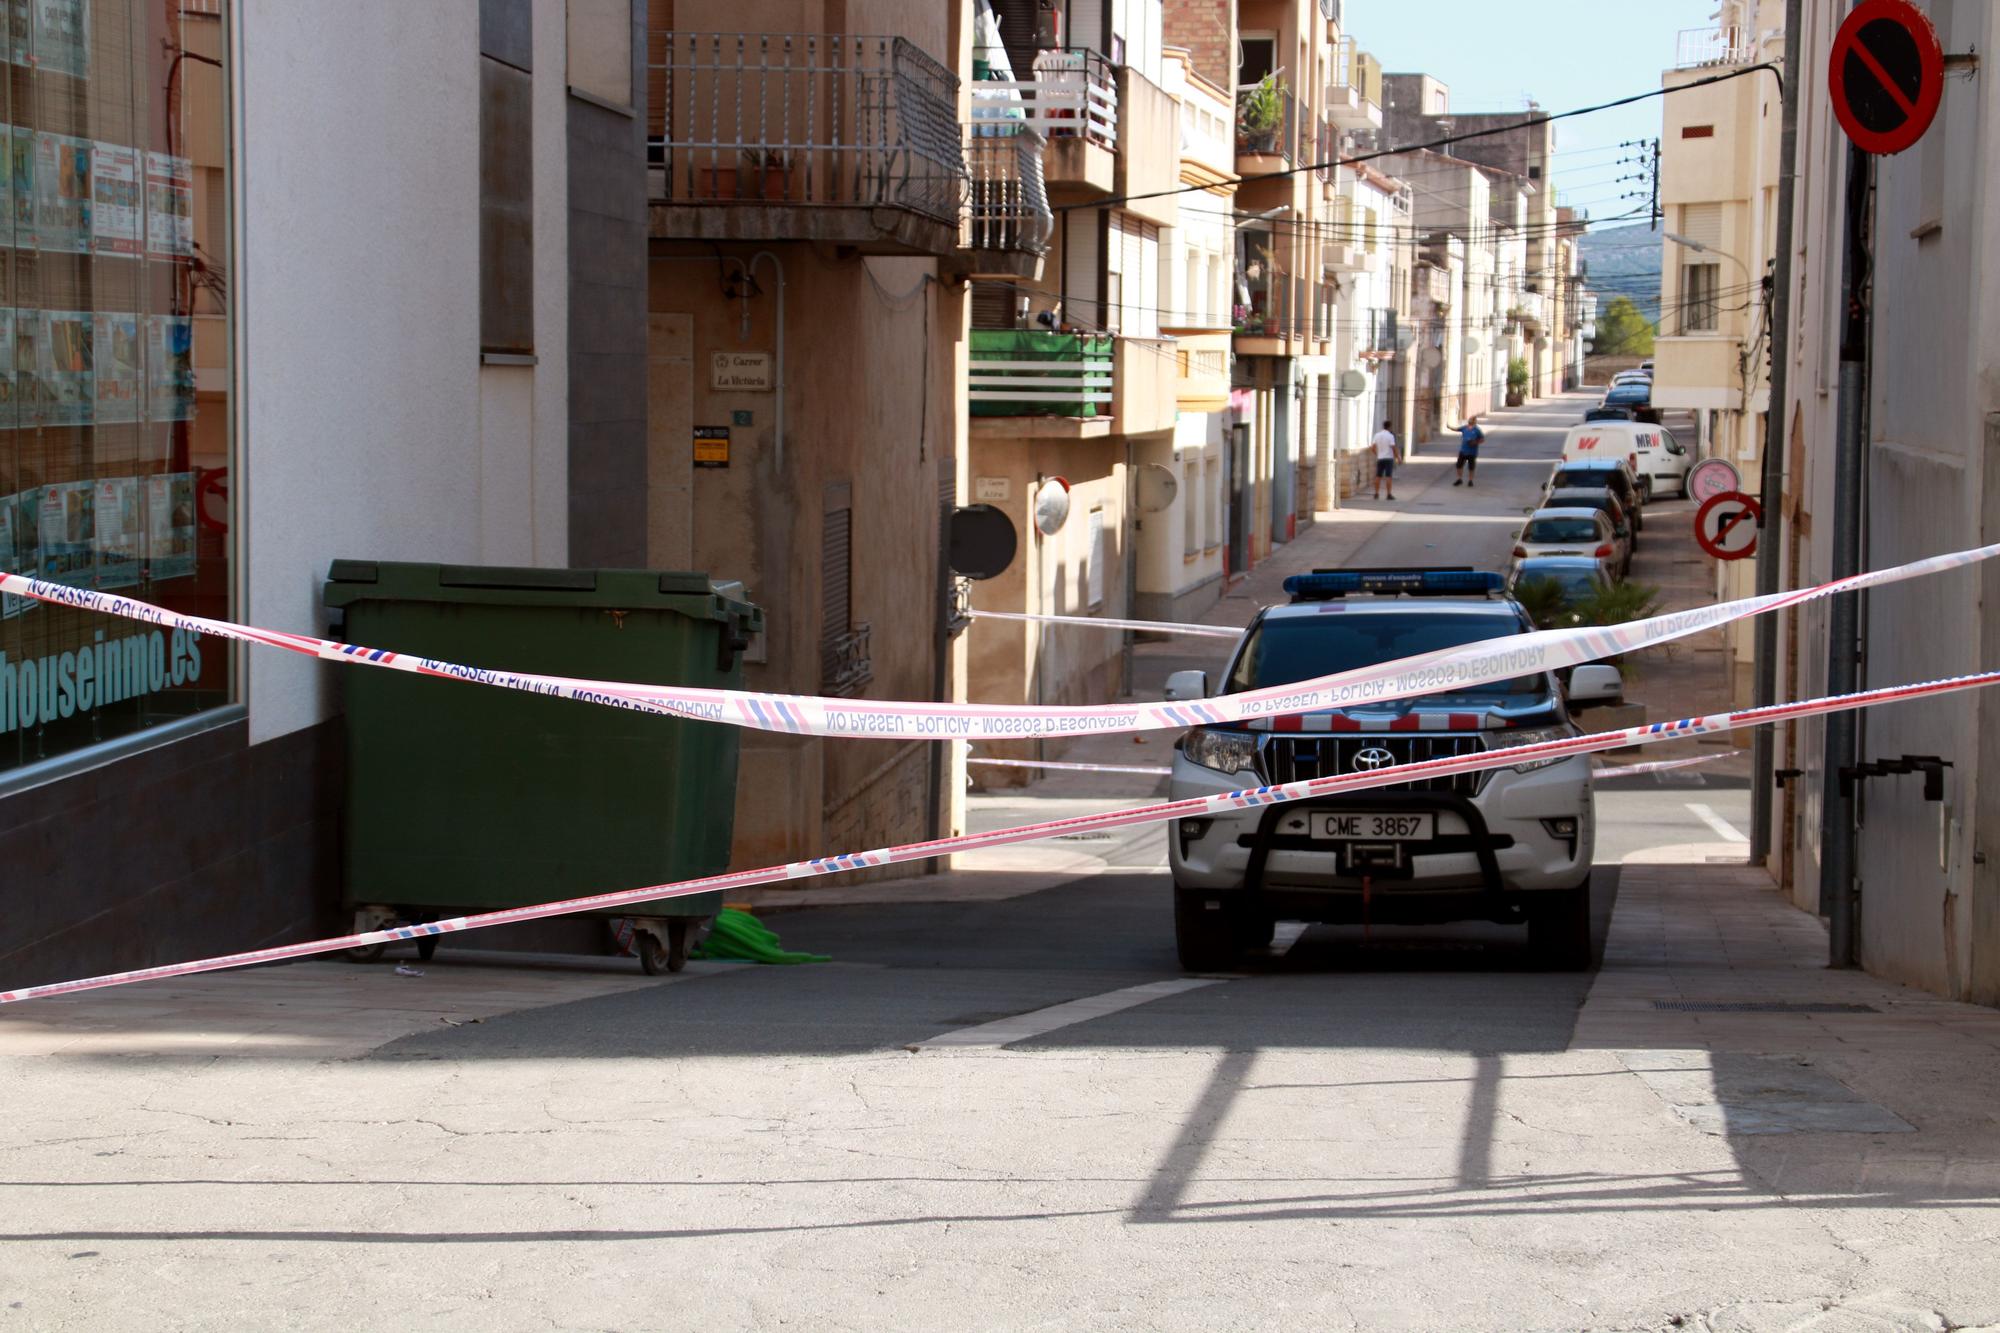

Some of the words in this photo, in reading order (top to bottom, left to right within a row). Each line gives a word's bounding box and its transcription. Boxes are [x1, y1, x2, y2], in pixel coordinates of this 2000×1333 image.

[733, 356, 762, 367] Carrer
[718, 375, 728, 385] La
[1635, 432, 1660, 449] MRW
[1325, 816, 1362, 836] CME
[1371, 816, 1422, 837] 3867
